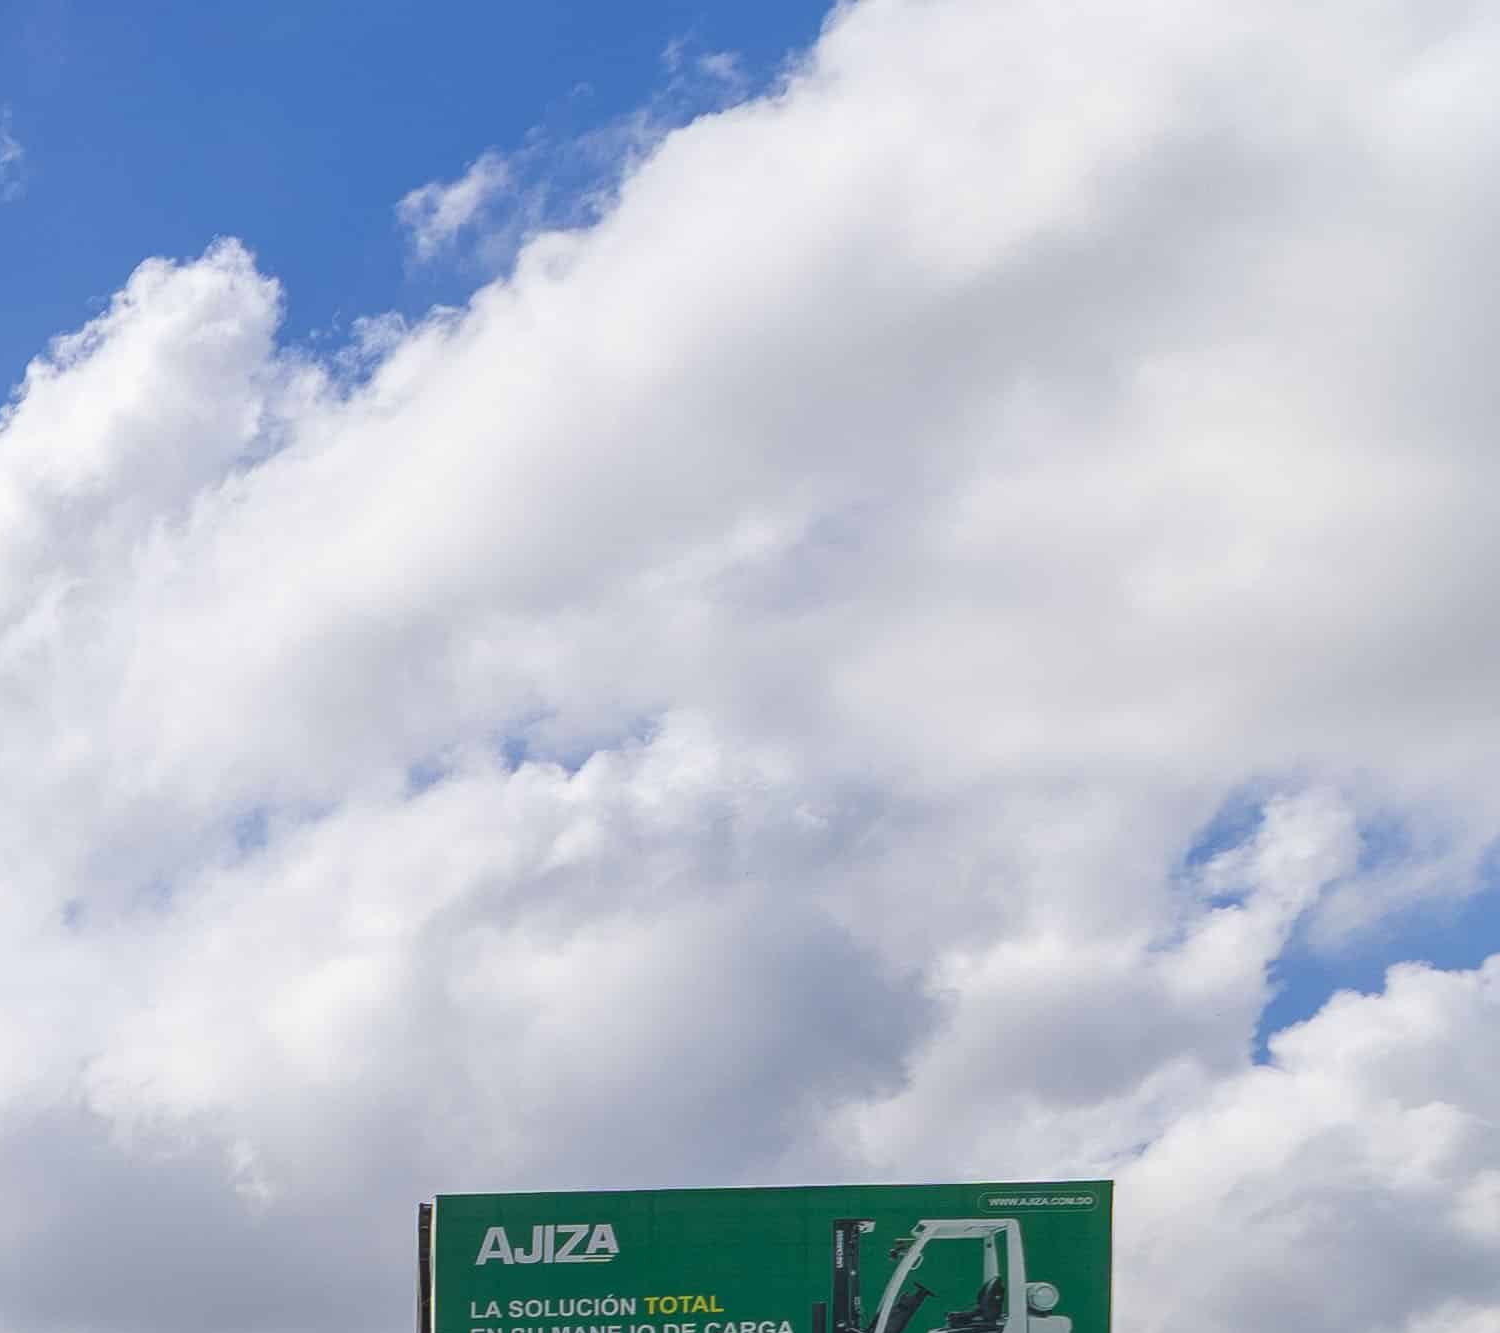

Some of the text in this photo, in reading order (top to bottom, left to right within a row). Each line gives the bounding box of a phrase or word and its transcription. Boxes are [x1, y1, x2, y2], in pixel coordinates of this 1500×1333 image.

[475, 1223, 620, 1265] AJIZA
[470, 1294, 725, 1319] LA SOLUCIÓN TOTAL
